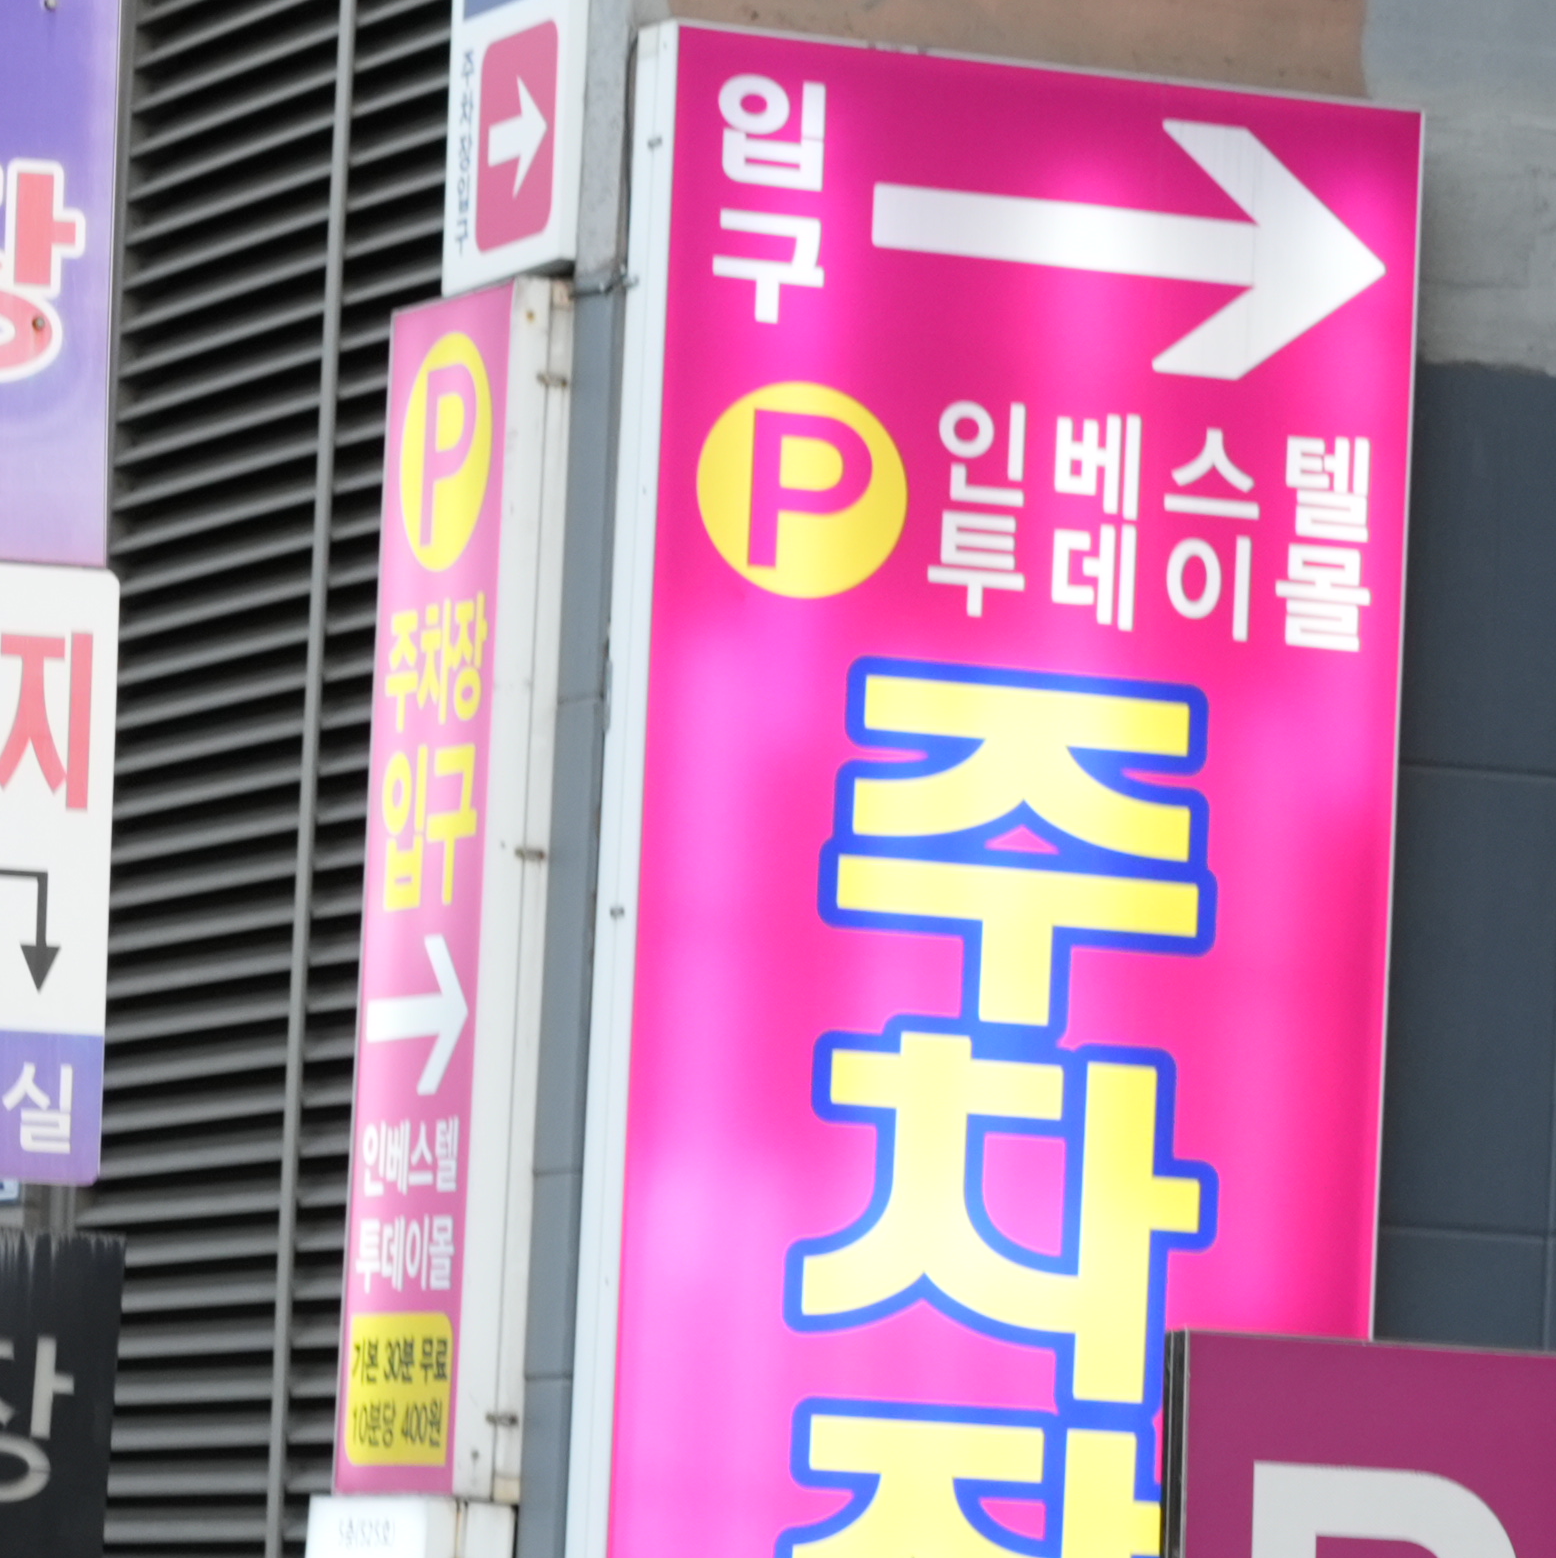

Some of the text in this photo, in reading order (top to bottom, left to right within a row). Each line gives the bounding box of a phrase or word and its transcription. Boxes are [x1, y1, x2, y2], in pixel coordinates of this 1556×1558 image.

[711, 74, 826, 323] 입구
[419, 360, 477, 548] P
[747, 407, 873, 569] P
[937, 400, 1370, 542] 인베스텔
[928, 510, 1370, 652] 투데이몰
[385, 592, 488, 734] 주차장
[380, 743, 477, 912] 입구
[362, 1115, 460, 1197] 인베스텔
[355, 1213, 455, 1294] 투데이몰
